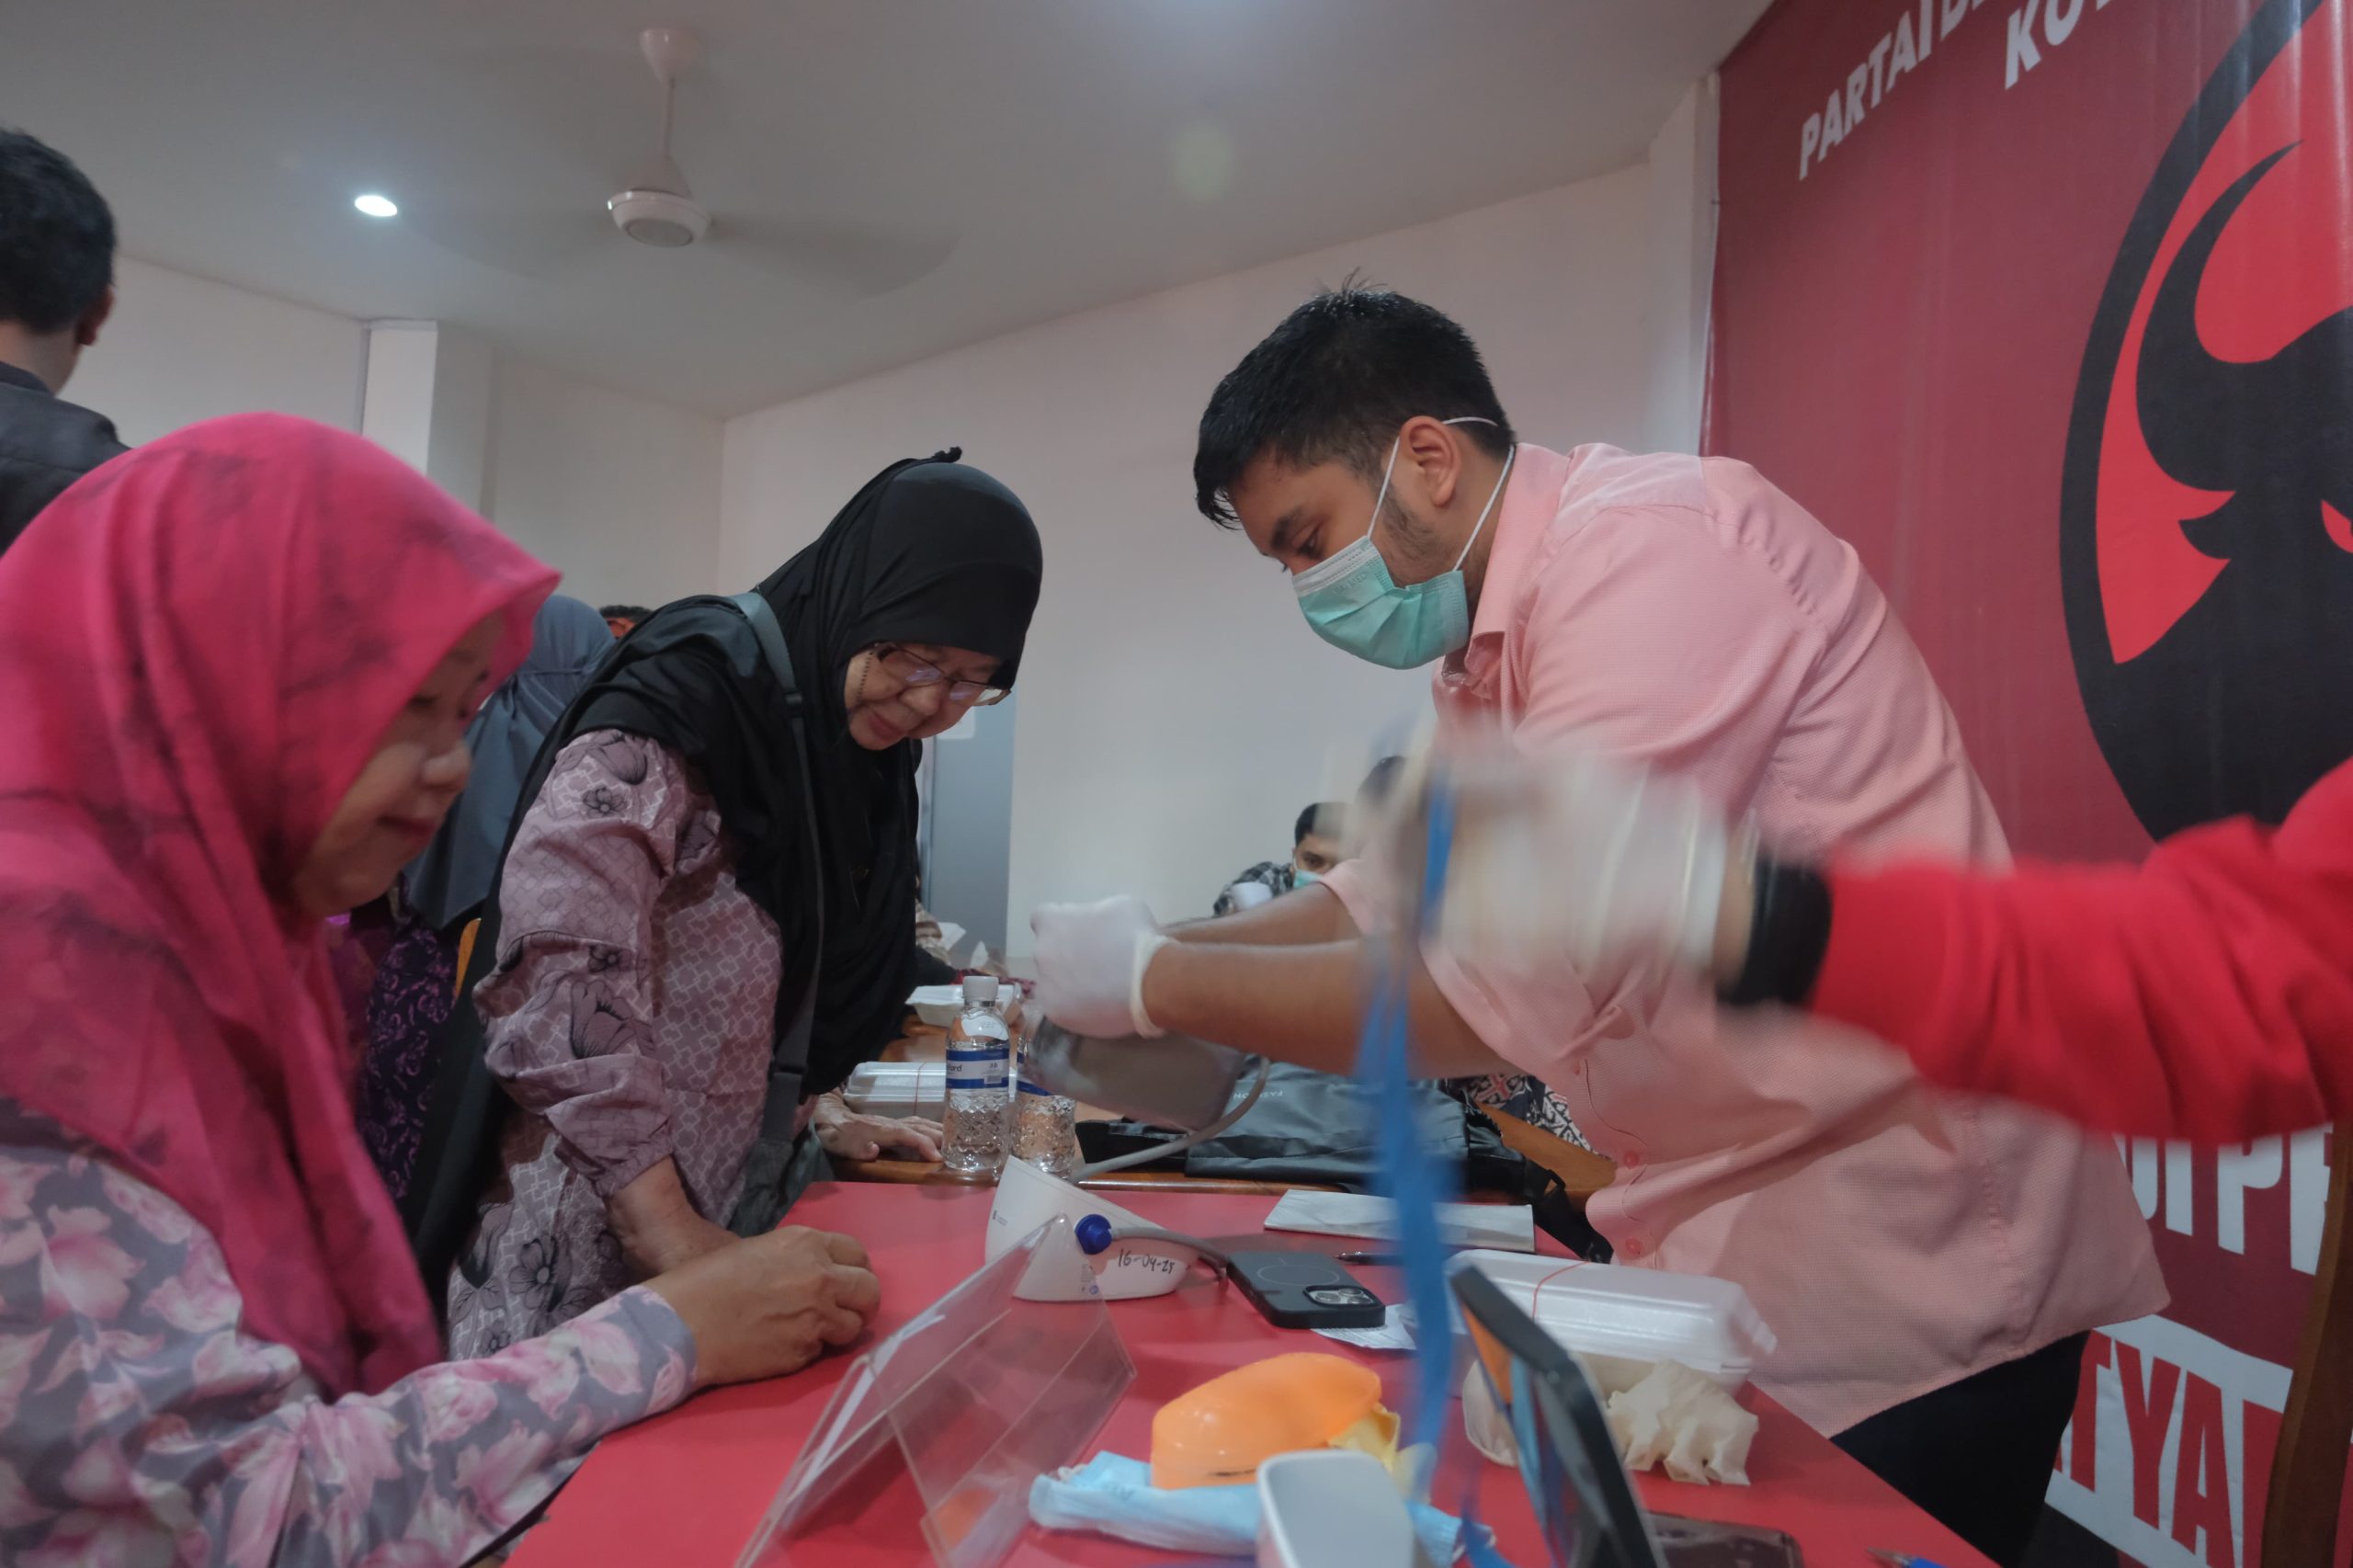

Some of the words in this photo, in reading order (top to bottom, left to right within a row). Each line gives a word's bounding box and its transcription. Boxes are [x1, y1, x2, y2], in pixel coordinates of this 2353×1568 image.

[1799, 0, 1932, 181] PARTAI
[2005, 0, 2111, 90] KO
[1233, 1090, 1284, 1100] FASON
[2217, 1122, 2333, 1276] PE
[1118, 1249, 1176, 1274] 16-04-25
[2054, 1329, 2284, 1568] TYA
